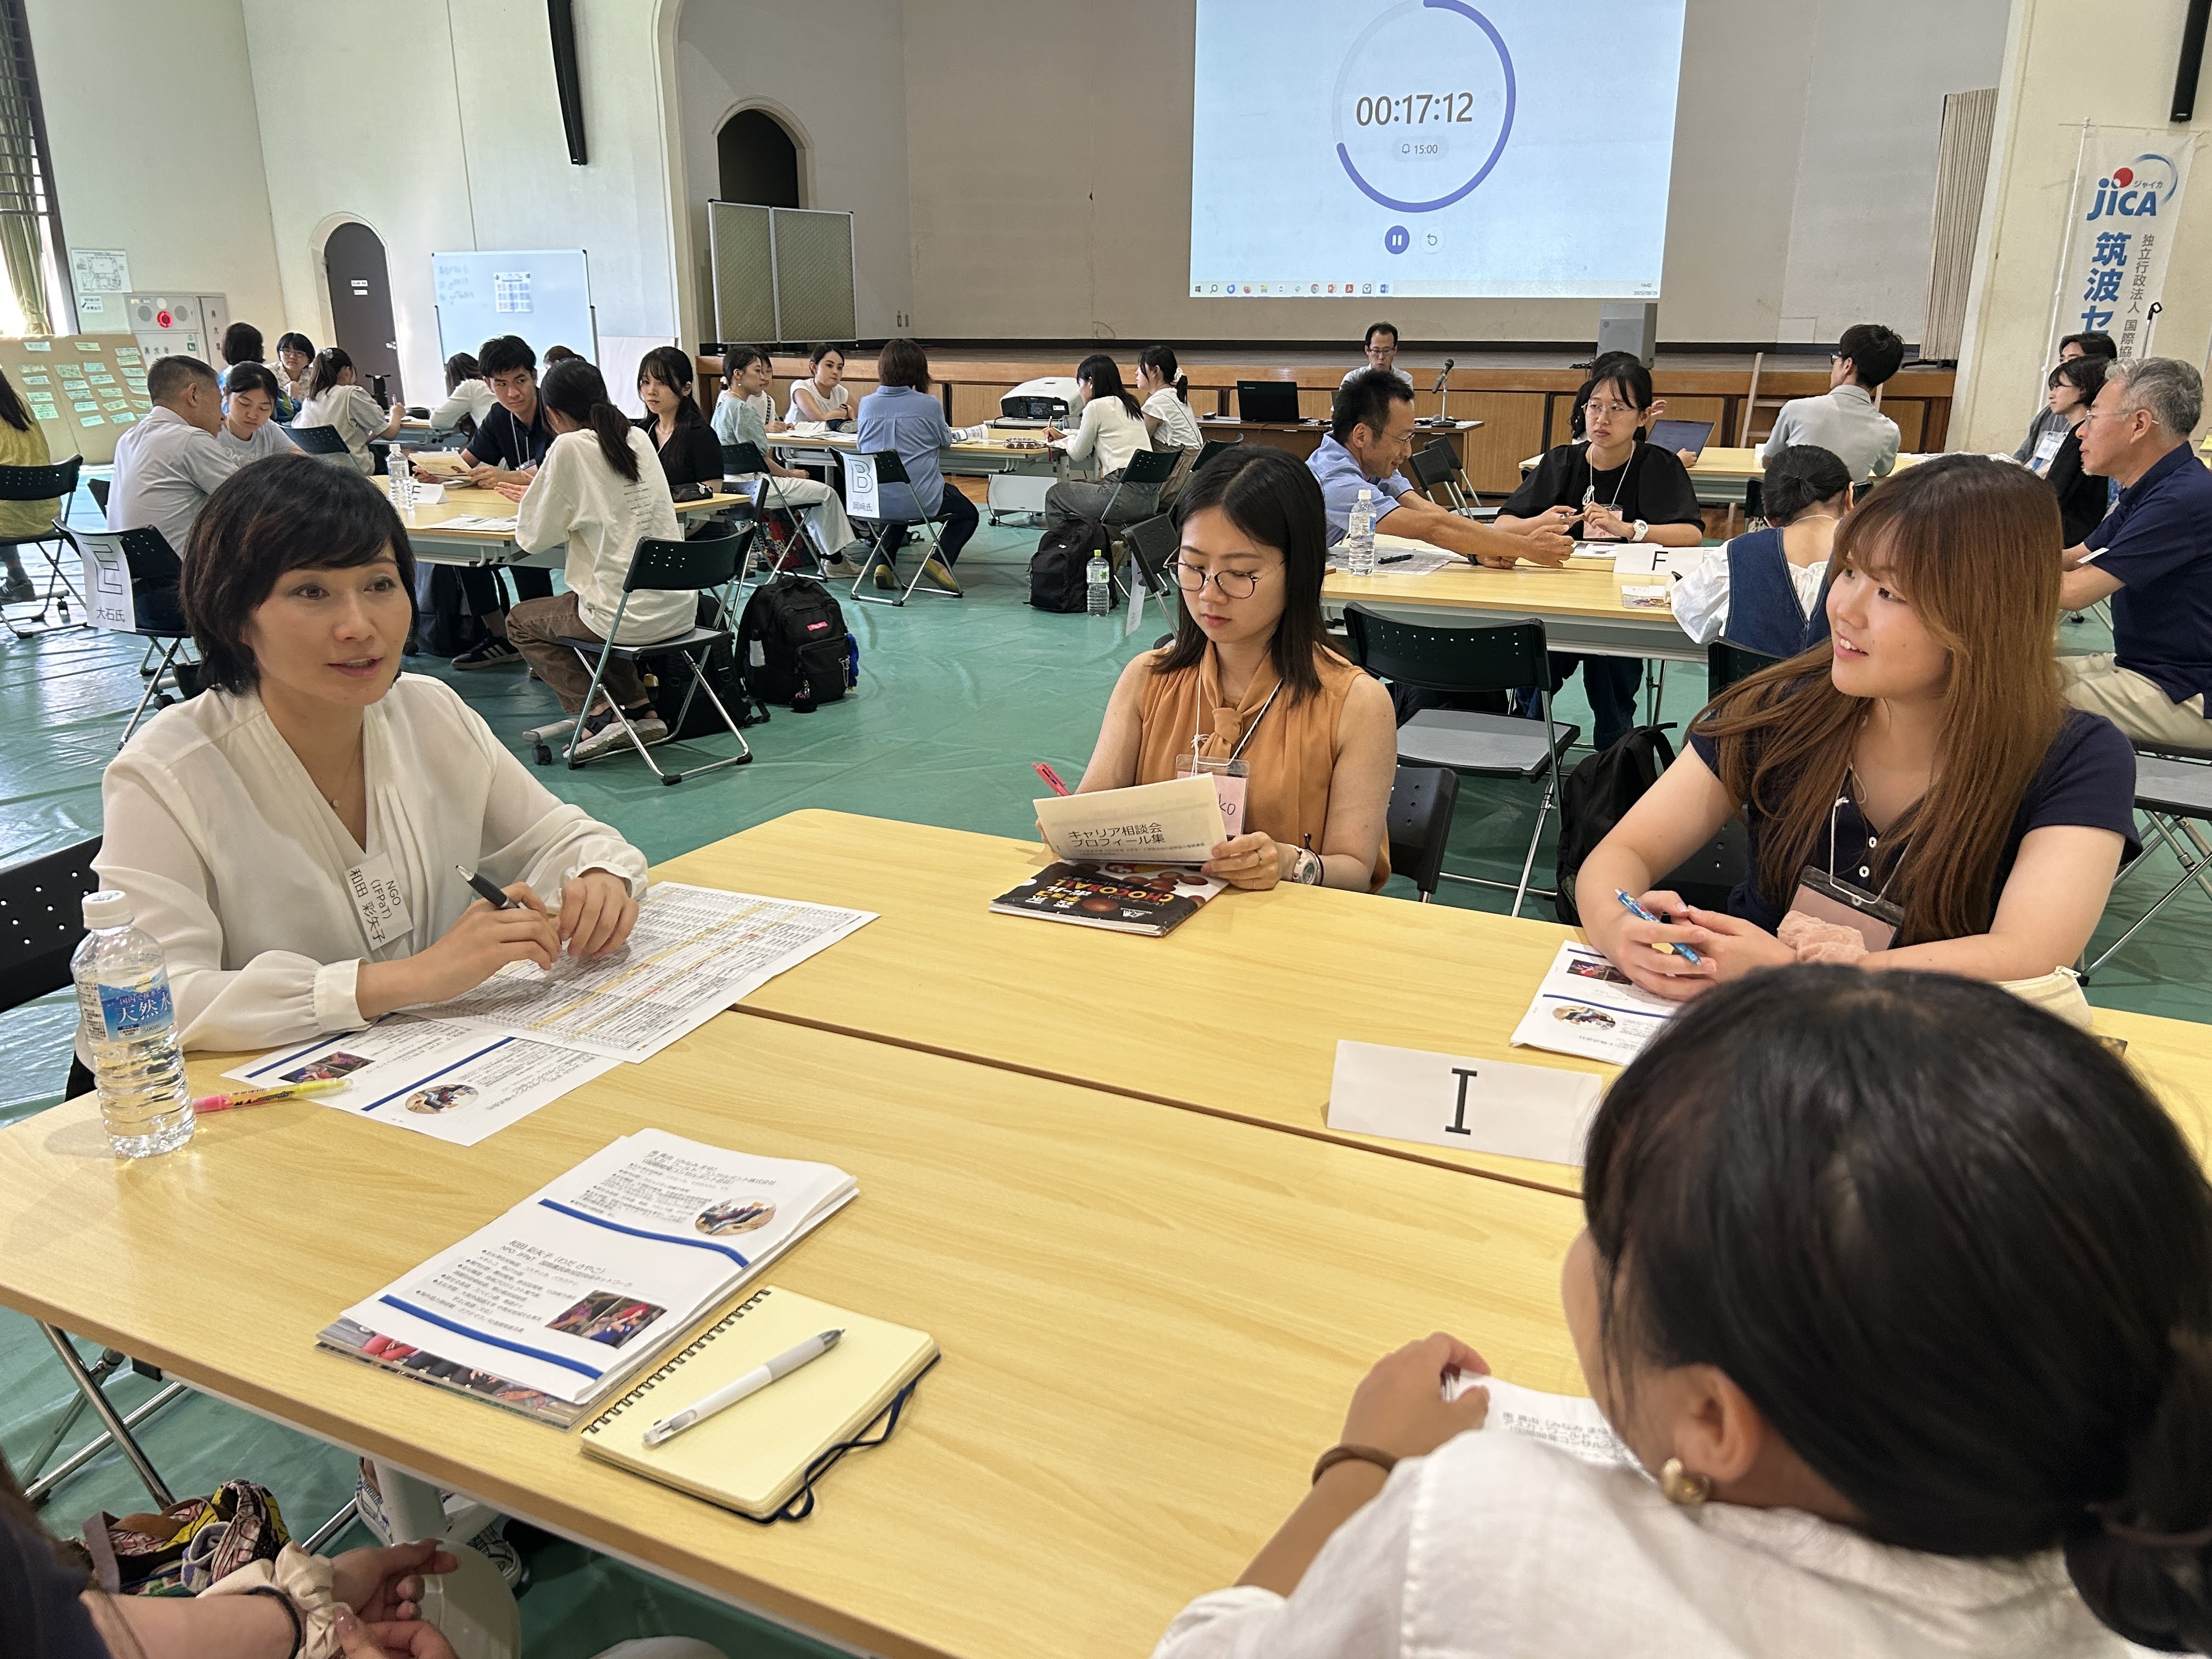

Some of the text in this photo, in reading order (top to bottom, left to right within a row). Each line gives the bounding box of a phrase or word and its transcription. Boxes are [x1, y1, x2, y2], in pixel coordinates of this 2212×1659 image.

[1356, 92, 1473, 126] 00:17:12
[1414, 144, 1438, 154] 15:00
[2134, 180, 2163, 189] ジャイカ
[2127, 234, 2155, 314] 独立行政法人
[848, 459, 873, 494] B
[1651, 551, 1669, 571] F
[97, 606, 125, 622] 大石氏
[1068, 822, 1163, 839] キャリア相談会
[1071, 833, 1166, 847] プロフィール集
[370, 879, 393, 919] (IFPaT)
[386, 880, 401, 906] NGO
[1054, 879, 1175, 902] CHOCOBALL
[349, 868, 386, 943] 和田 彩矢子
[114, 991, 171, 1024] 天然水
